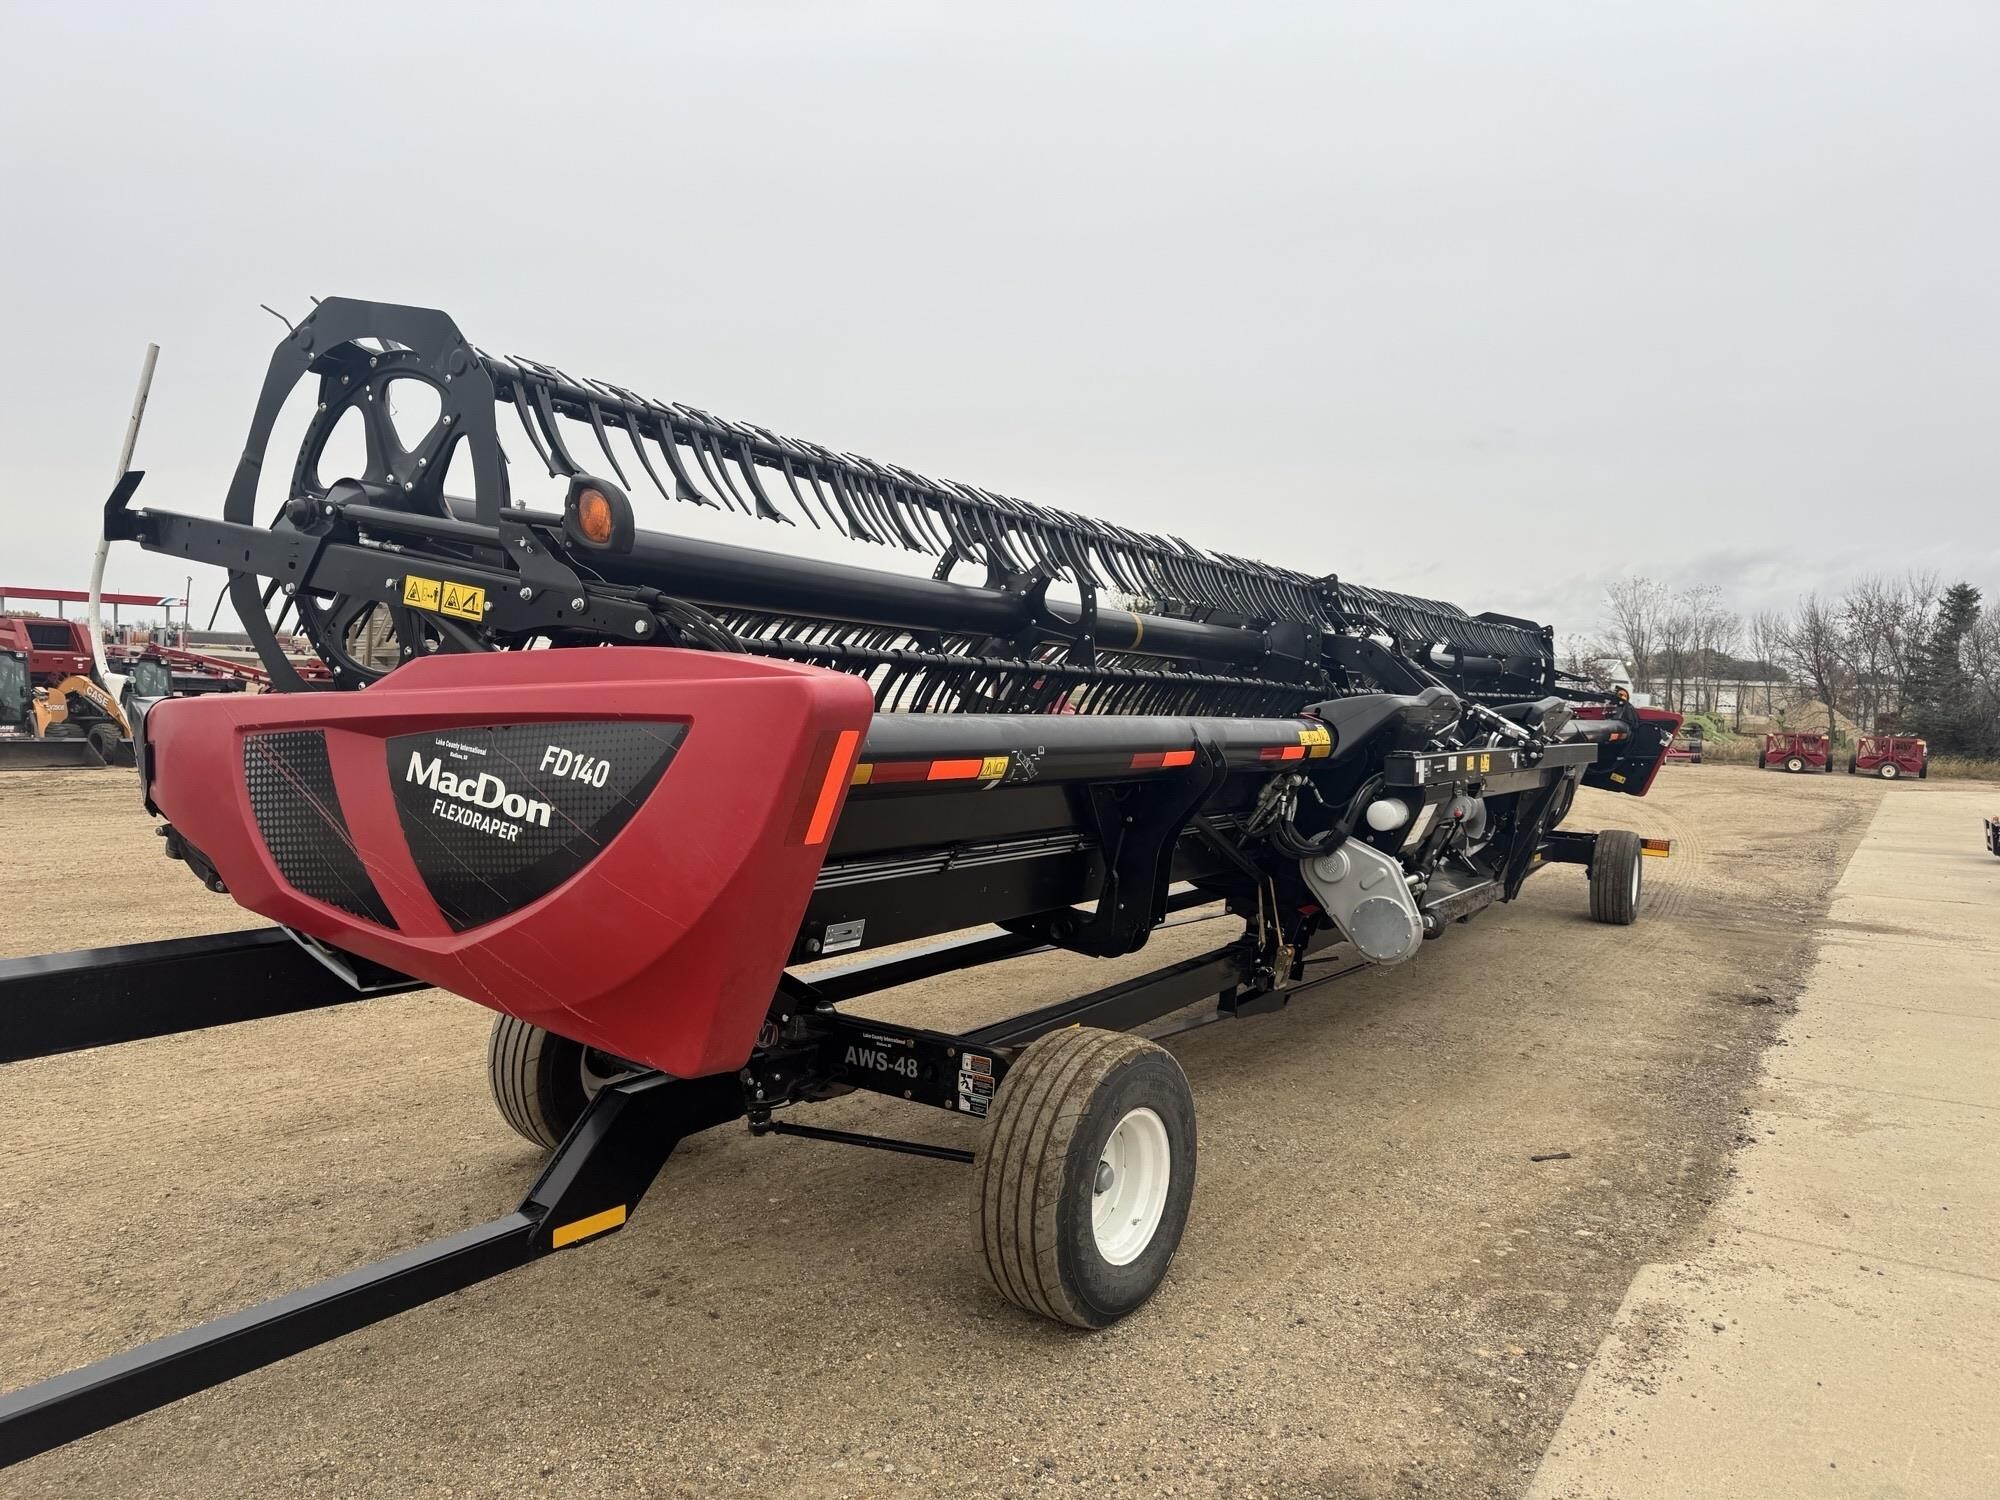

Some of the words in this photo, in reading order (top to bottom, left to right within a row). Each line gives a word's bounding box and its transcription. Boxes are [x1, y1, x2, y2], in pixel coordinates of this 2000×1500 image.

[86, 687, 109, 707] CASE
[445, 740, 460, 750] County
[460, 743, 487, 756] International
[539, 745, 611, 788] FD140
[405, 751, 551, 828] MacDon
[844, 1045, 918, 1078] AWS-48
